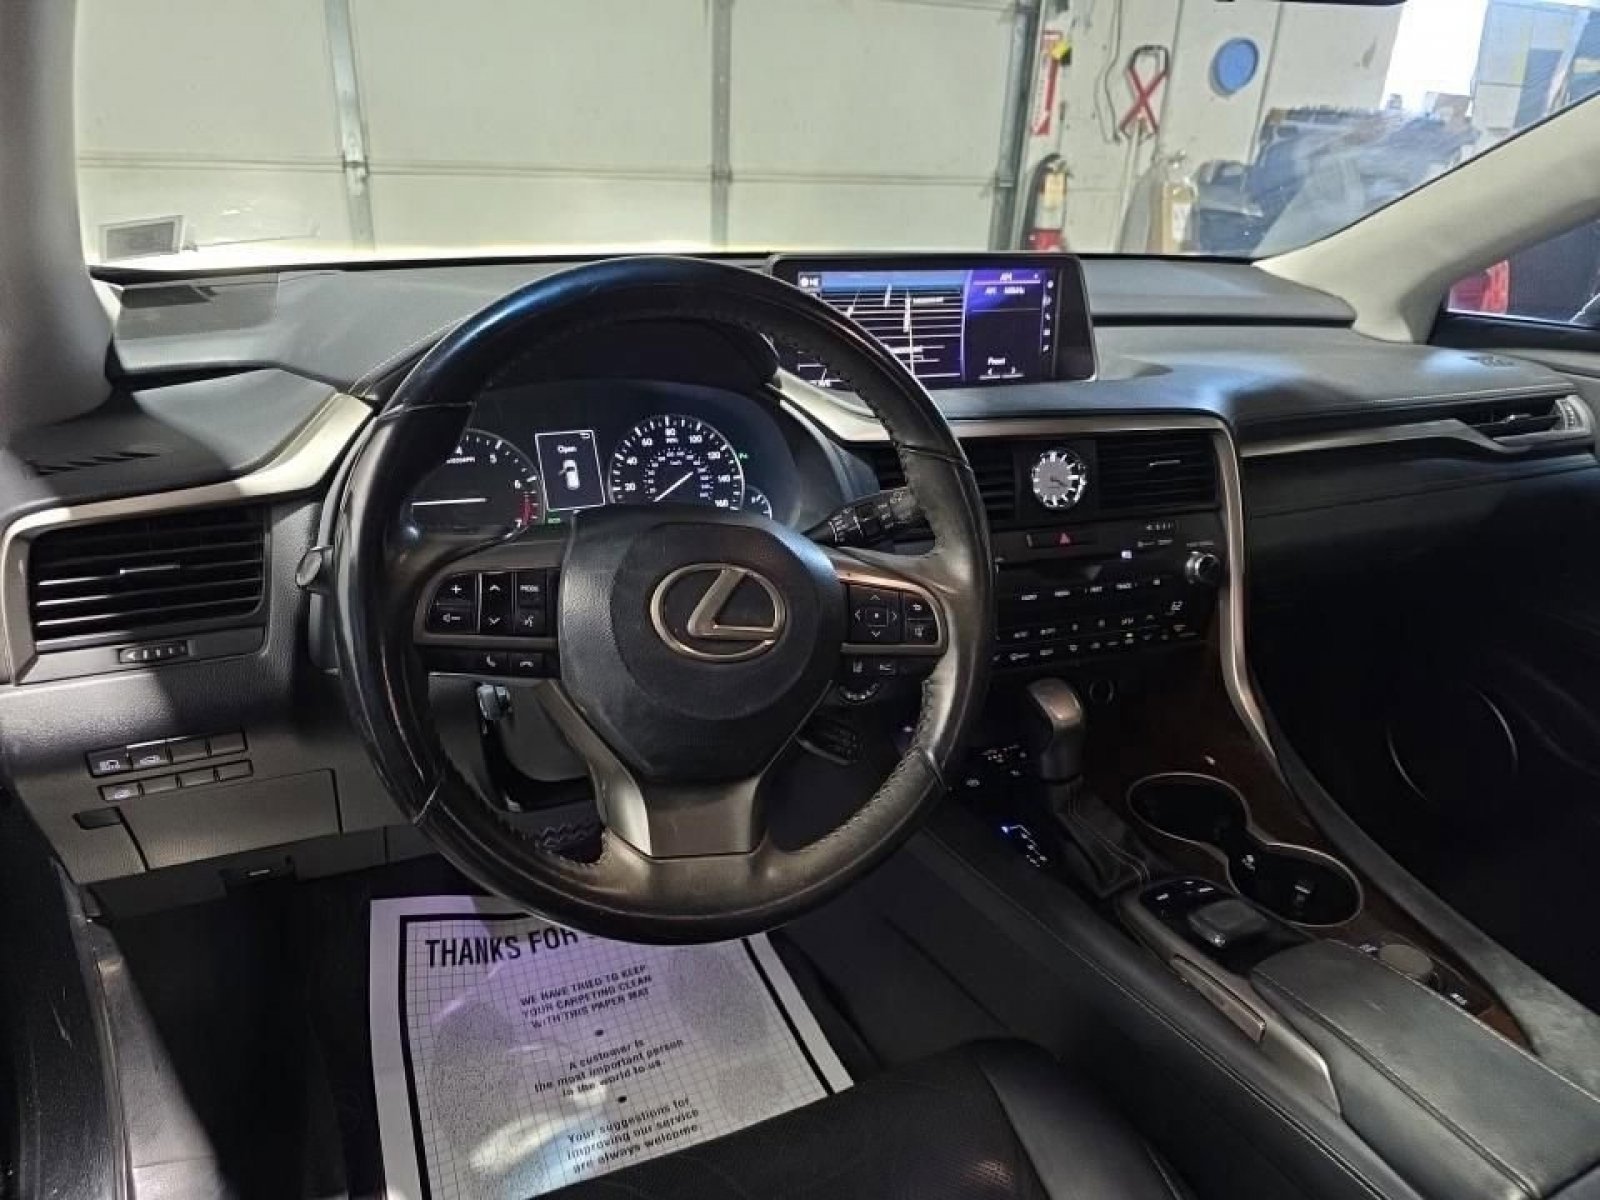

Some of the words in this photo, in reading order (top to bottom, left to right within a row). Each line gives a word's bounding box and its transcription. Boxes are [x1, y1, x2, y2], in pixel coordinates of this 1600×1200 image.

[557, 445, 578, 453] Open
[641, 437, 653, 447] 60
[689, 434, 703, 444] 100
[626, 456, 638, 465] 40
[624, 482, 636, 491] 20
[425, 935, 521, 968] THANKS
[527, 927, 579, 954] FOR
[520, 994, 536, 1006] WE
[541, 986, 568, 1001] HAVE
[572, 977, 603, 993] TRIED
[605, 972, 619, 982] TO
[621, 964, 647, 979] KEEP
[521, 1002, 554, 1018] YOUR
[556, 985, 616, 1009] CARPETING
[618, 974, 653, 991] CLEAN
[531, 1013, 561, 1028] WITH
[562, 1005, 589, 1021] THIS
[591, 994, 626, 1012] PAPER
[627, 986, 649, 1001] MAT
[534, 1080, 553, 1094] the
[557, 1071, 587, 1087] most
[589, 1052, 645, 1078] important
[646, 1040, 685, 1060] person
[569, 1061, 577, 1071] A
[580, 1044, 632, 1068] customer
[577, 1082, 596, 1094] the
[600, 1068, 632, 1086] world
[632, 1065, 646, 1075] to
[567, 1129, 596, 1144] Your
[599, 1105, 671, 1134] suggestions
[672, 1096, 690, 1109] for
[633, 1124, 653, 1137] our
[656, 1109, 699, 1129] service
[573, 1160, 594, 1174] are
[598, 1144, 641, 1165] always
